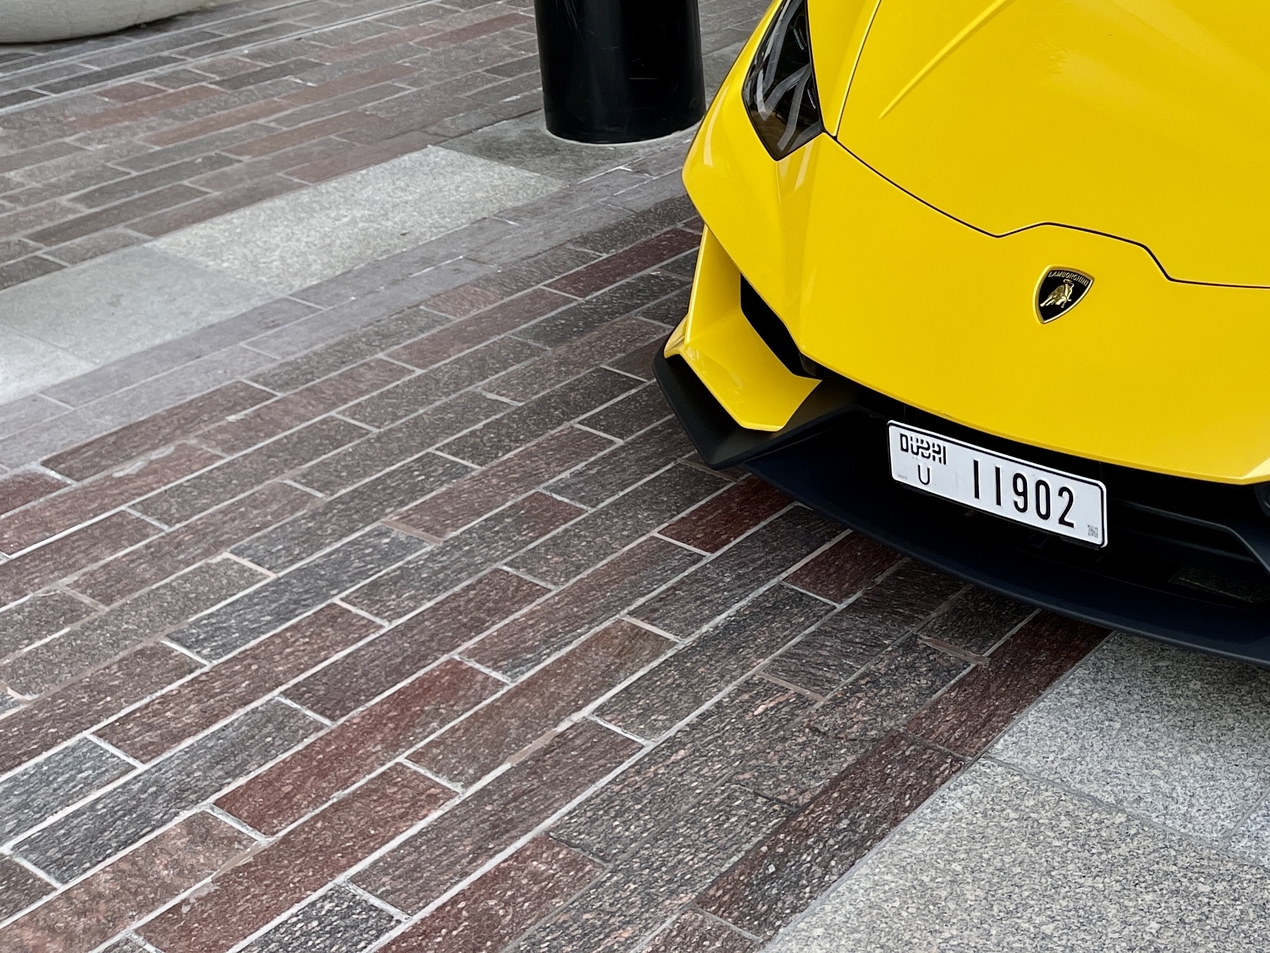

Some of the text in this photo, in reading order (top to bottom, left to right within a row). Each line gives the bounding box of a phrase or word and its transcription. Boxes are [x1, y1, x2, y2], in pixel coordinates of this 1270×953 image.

[1047, 270, 1090, 287] LAMBORGHINI
[917, 464, 931, 485] U
[973, 459, 1075, 528] 11902
